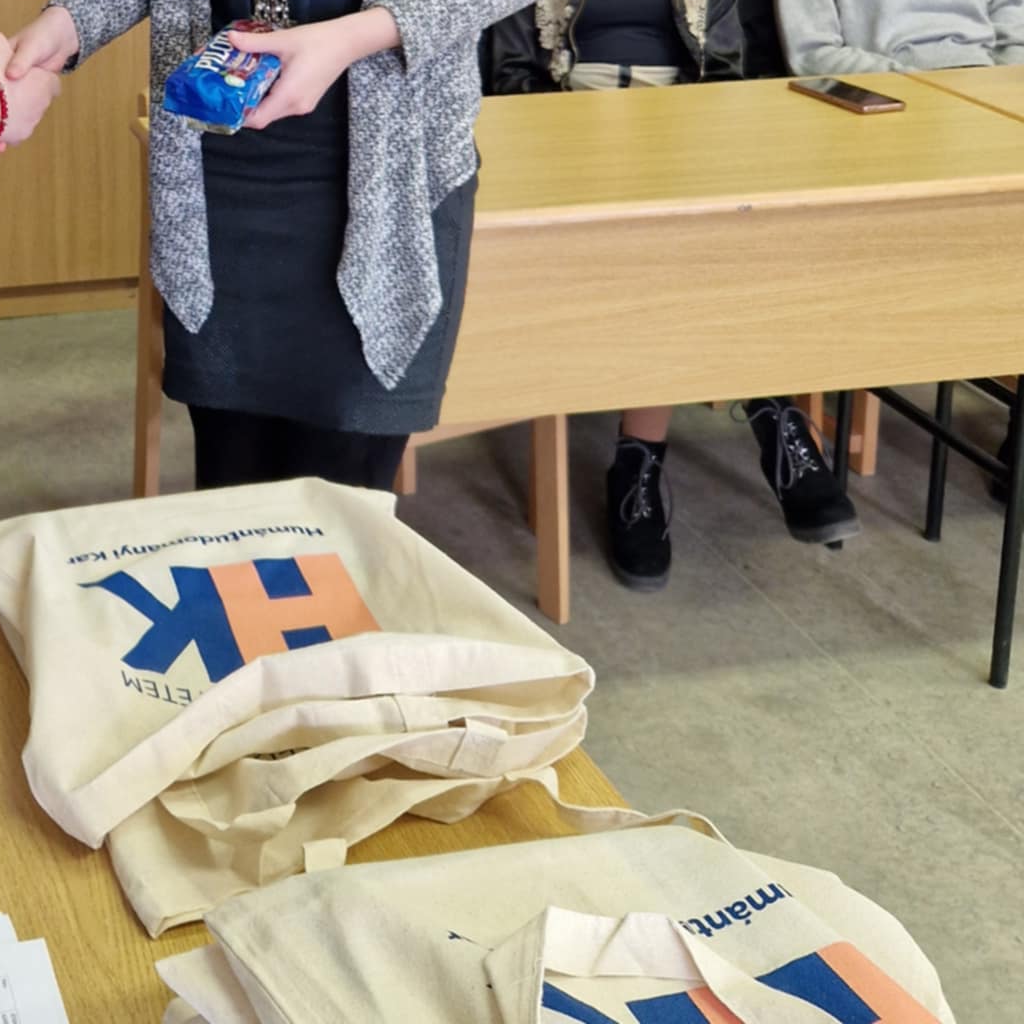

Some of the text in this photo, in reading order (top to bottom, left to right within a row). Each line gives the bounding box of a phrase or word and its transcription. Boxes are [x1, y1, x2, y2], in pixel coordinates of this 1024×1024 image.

[66, 525, 324, 567] Humántudományi Kar
[121, 671, 205, 707] ETEM
[681, 882, 791, 939] mánt
